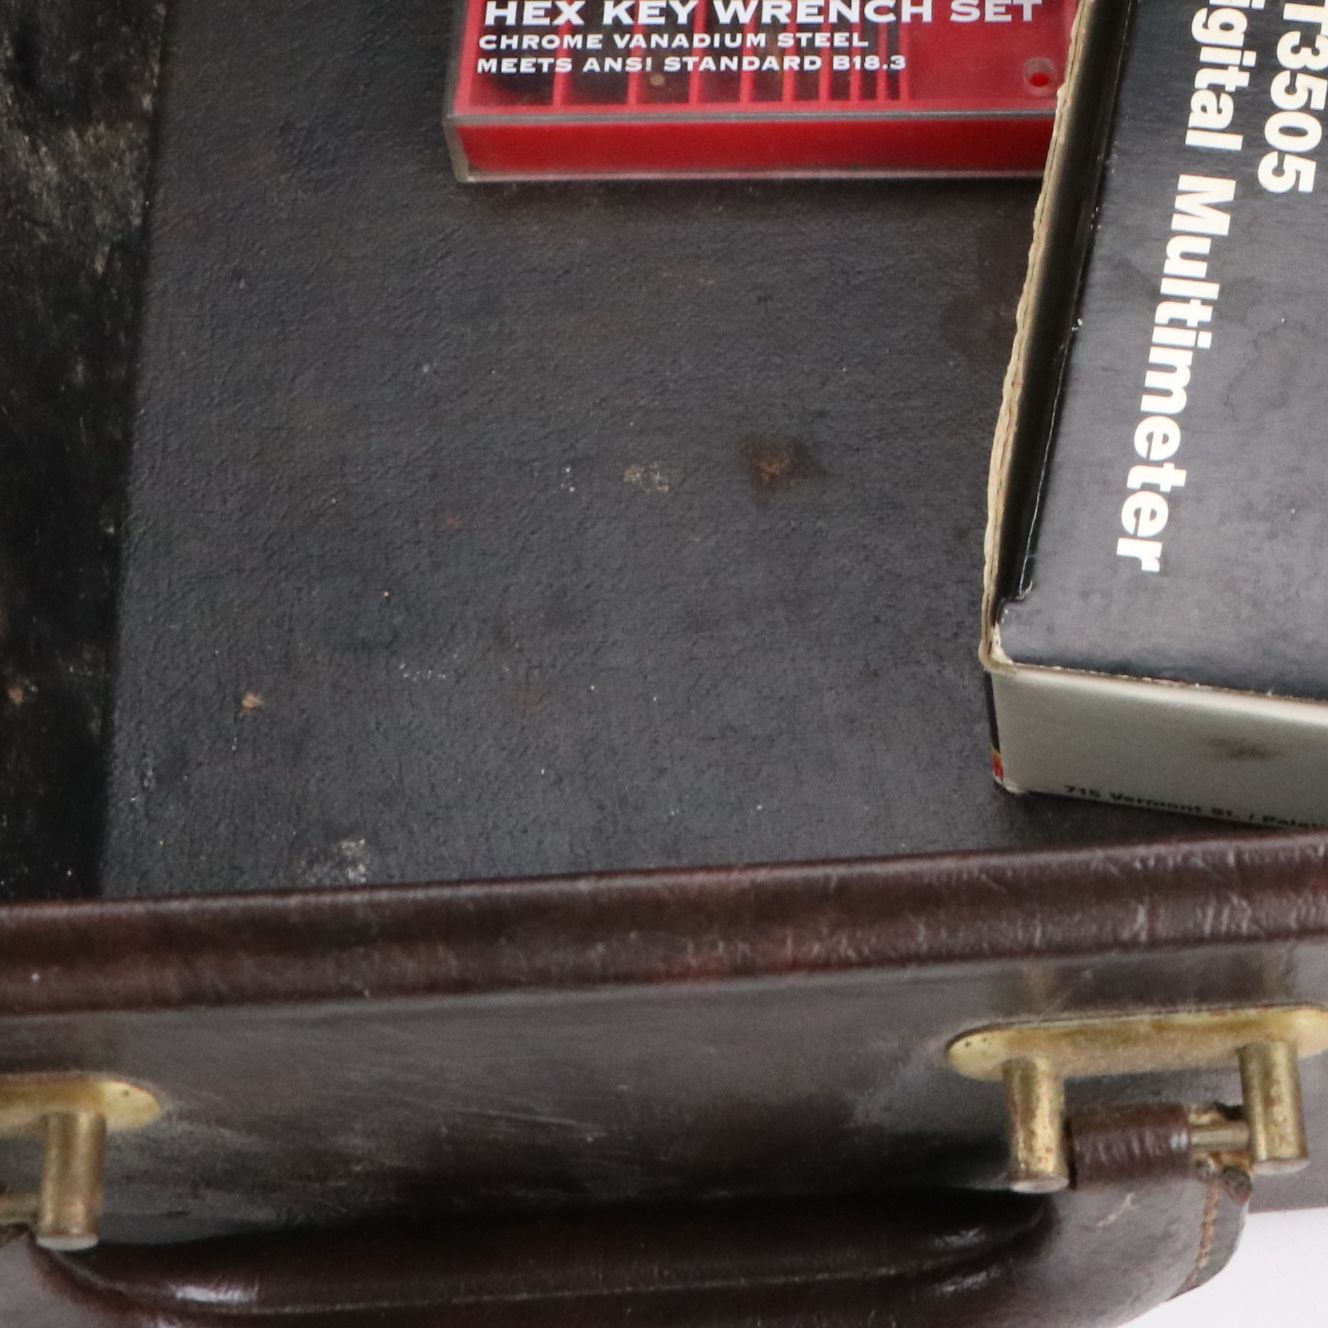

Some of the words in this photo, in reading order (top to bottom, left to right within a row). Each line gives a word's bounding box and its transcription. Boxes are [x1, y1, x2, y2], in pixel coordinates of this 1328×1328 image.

[484, 0, 586, 26] HEX
[602, 0, 699, 25] KEY
[479, 33, 603, 51] CHROME
[613, 33, 767, 50] VANADIUM
[777, 32, 869, 48] STEEL
[477, 57, 573, 74] MEETS
[583, 56, 652, 73] ANSI
[664, 55, 822, 72] STANDARD
[832, 55, 906, 71] B18.3
[1116, 173, 1237, 573] Multimeter
[1110, 792, 1202, 813] Vermont
